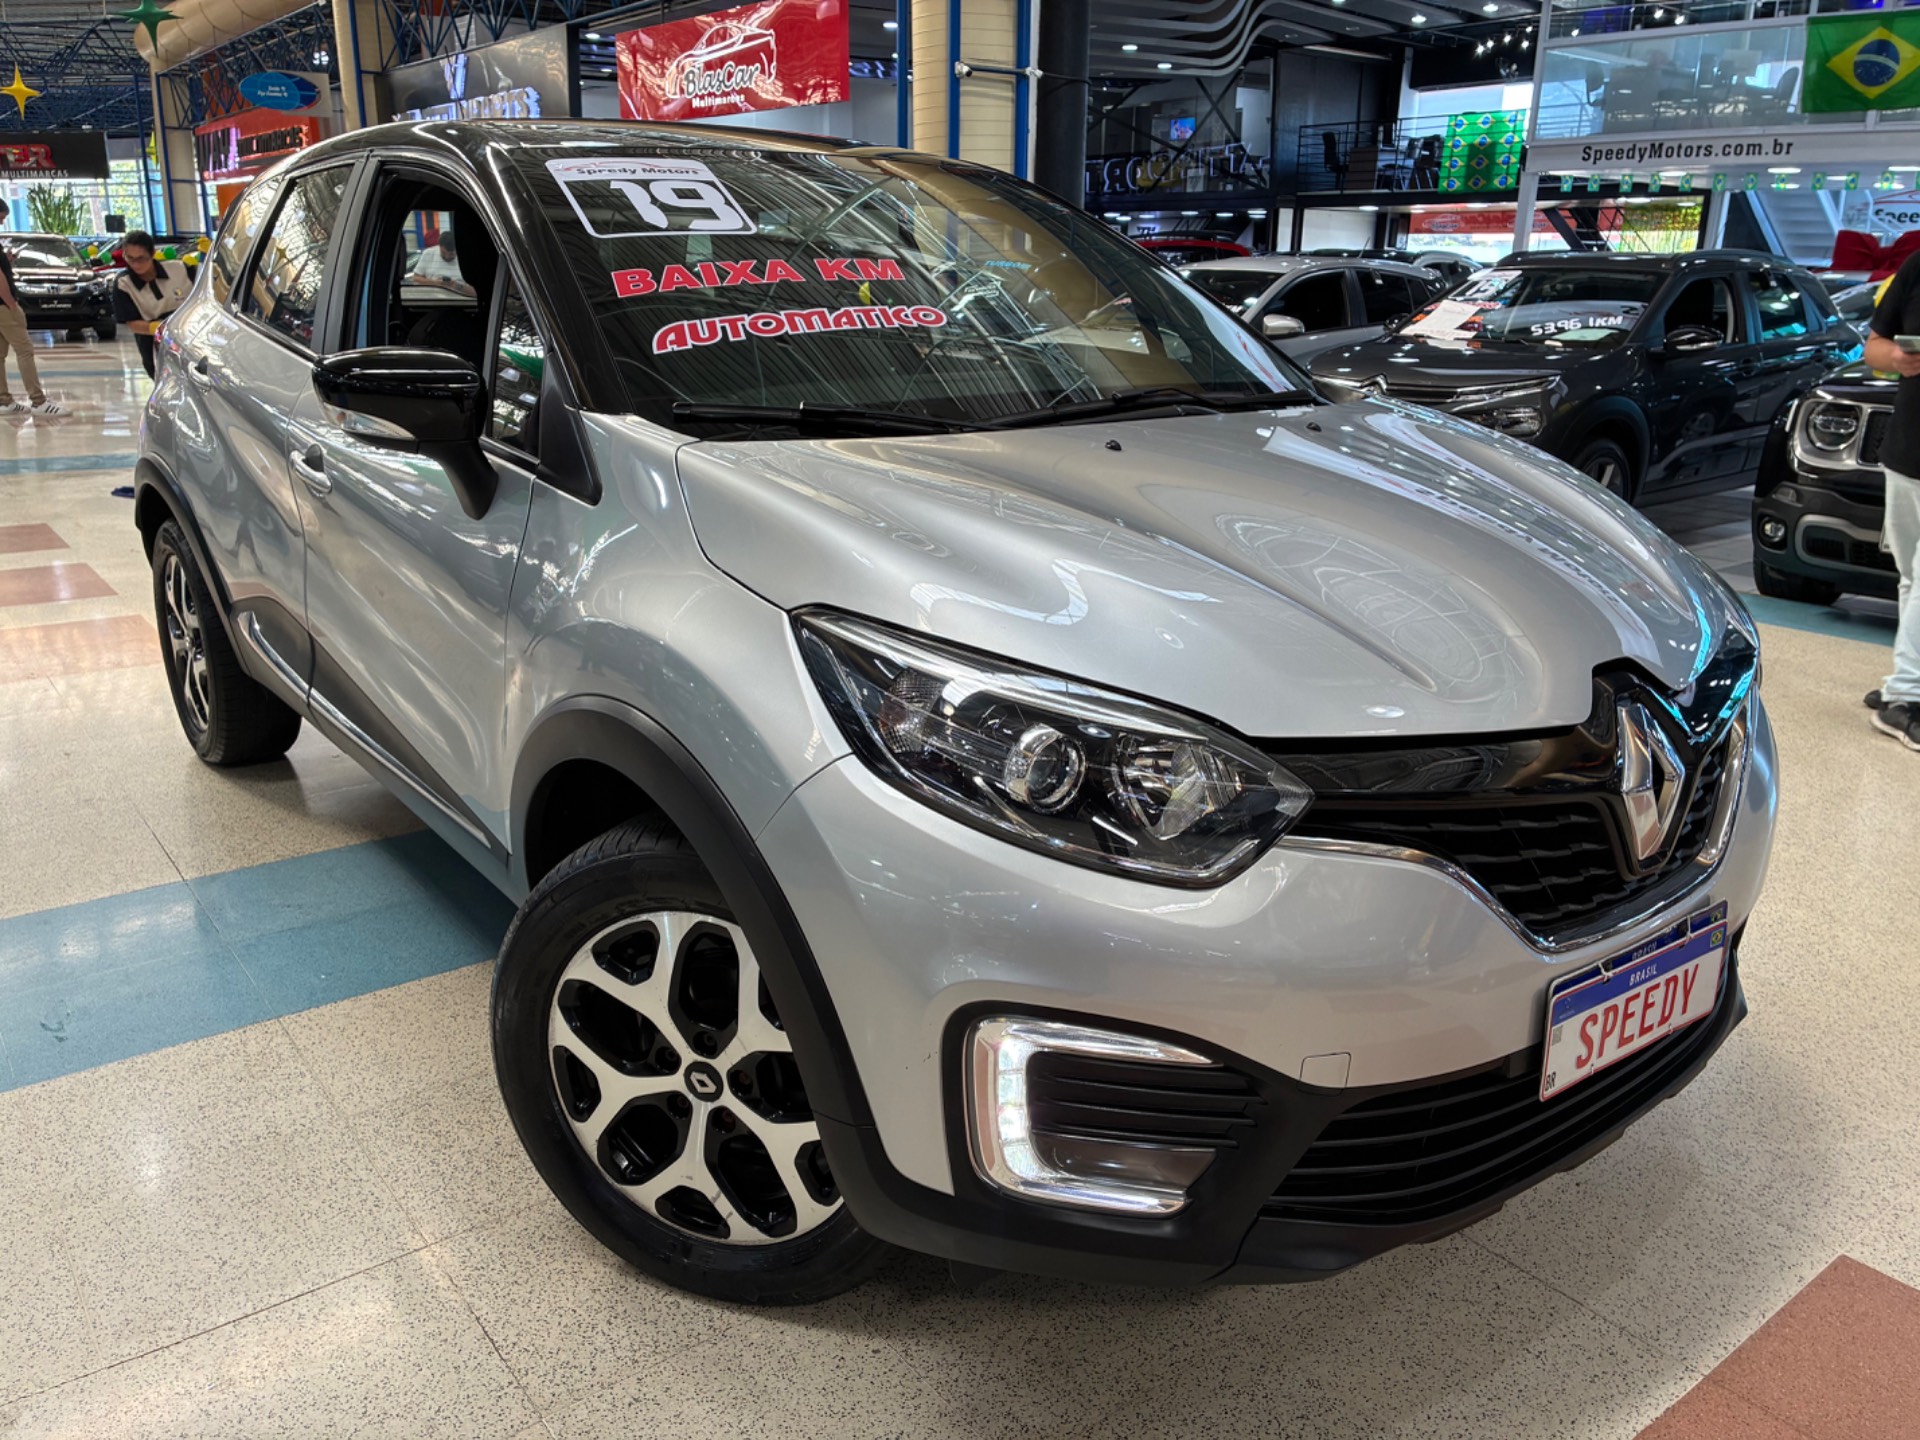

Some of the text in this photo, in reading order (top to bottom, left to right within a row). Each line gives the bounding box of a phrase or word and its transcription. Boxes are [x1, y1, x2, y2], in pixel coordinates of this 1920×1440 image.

[685, 61, 760, 98] BlasCar
[1582, 139, 1794, 165] SpeedyMotors.com.br
[1, 169, 69, 178] MULTIMARCAS
[642, 167, 700, 175] Motors
[610, 180, 744, 230] 19
[611, 258, 906, 298] BAIXA KM
[652, 305, 947, 354] AUTOMATICO
[1629, 964, 1658, 986] BRASIL
[1576, 964, 1698, 1069] SPEEDY
[1545, 1071, 1556, 1091] BR
